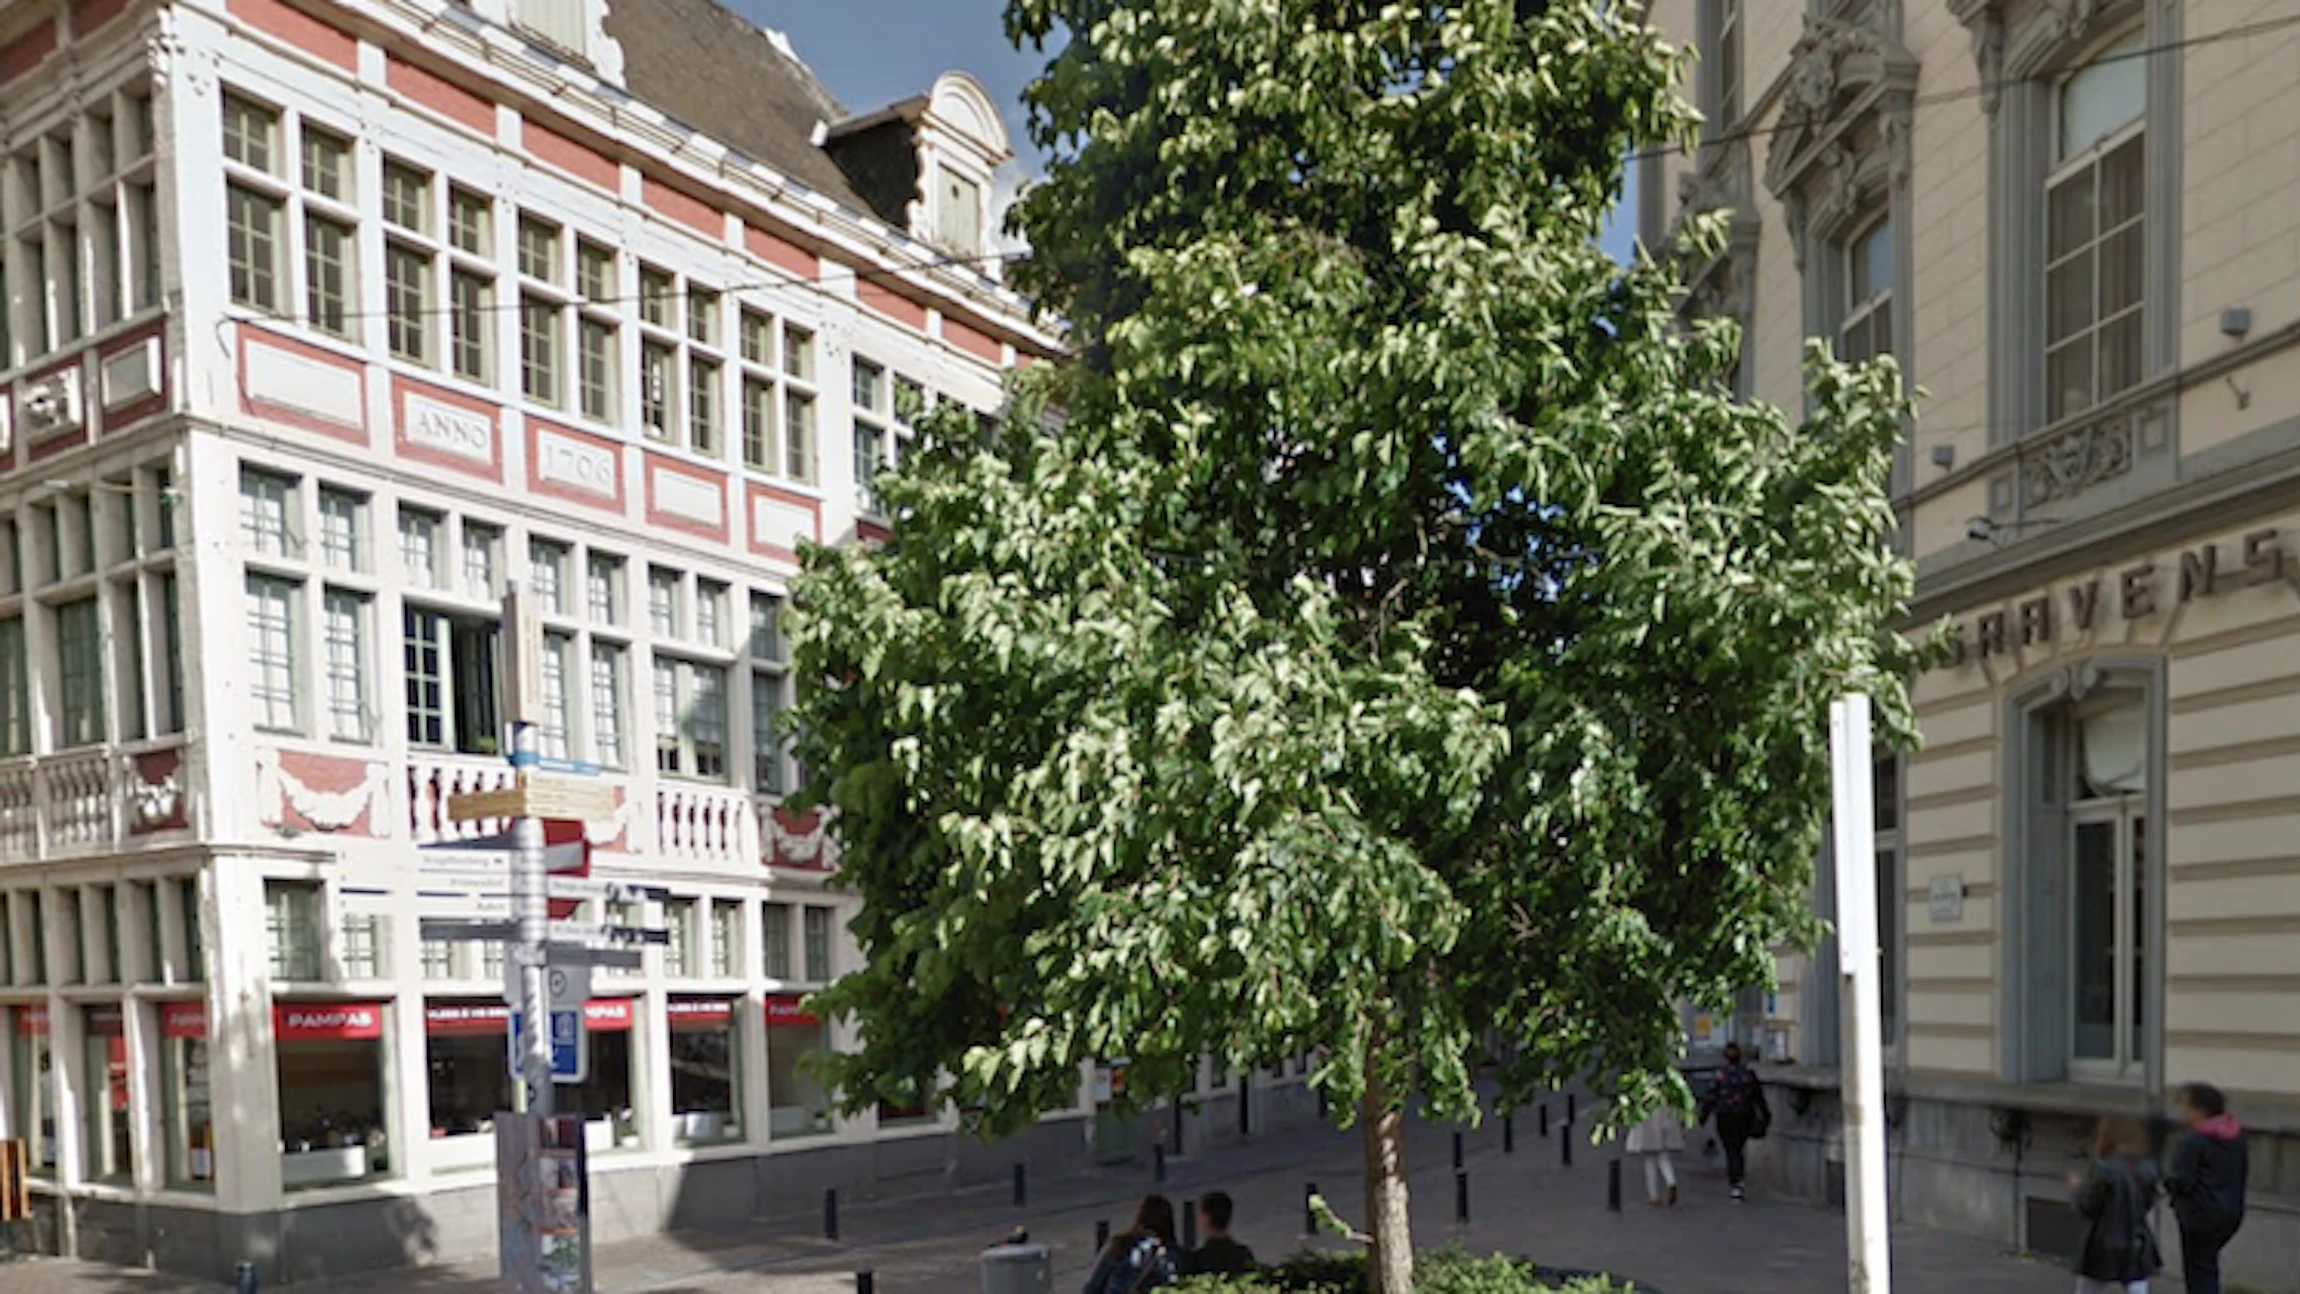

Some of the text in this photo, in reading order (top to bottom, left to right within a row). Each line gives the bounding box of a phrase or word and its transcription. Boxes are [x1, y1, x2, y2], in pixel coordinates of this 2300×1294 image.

[418, 411, 489, 451] ANNO
[545, 443, 612, 485] 1706
[286, 1010, 373, 1029] PAMPAS
